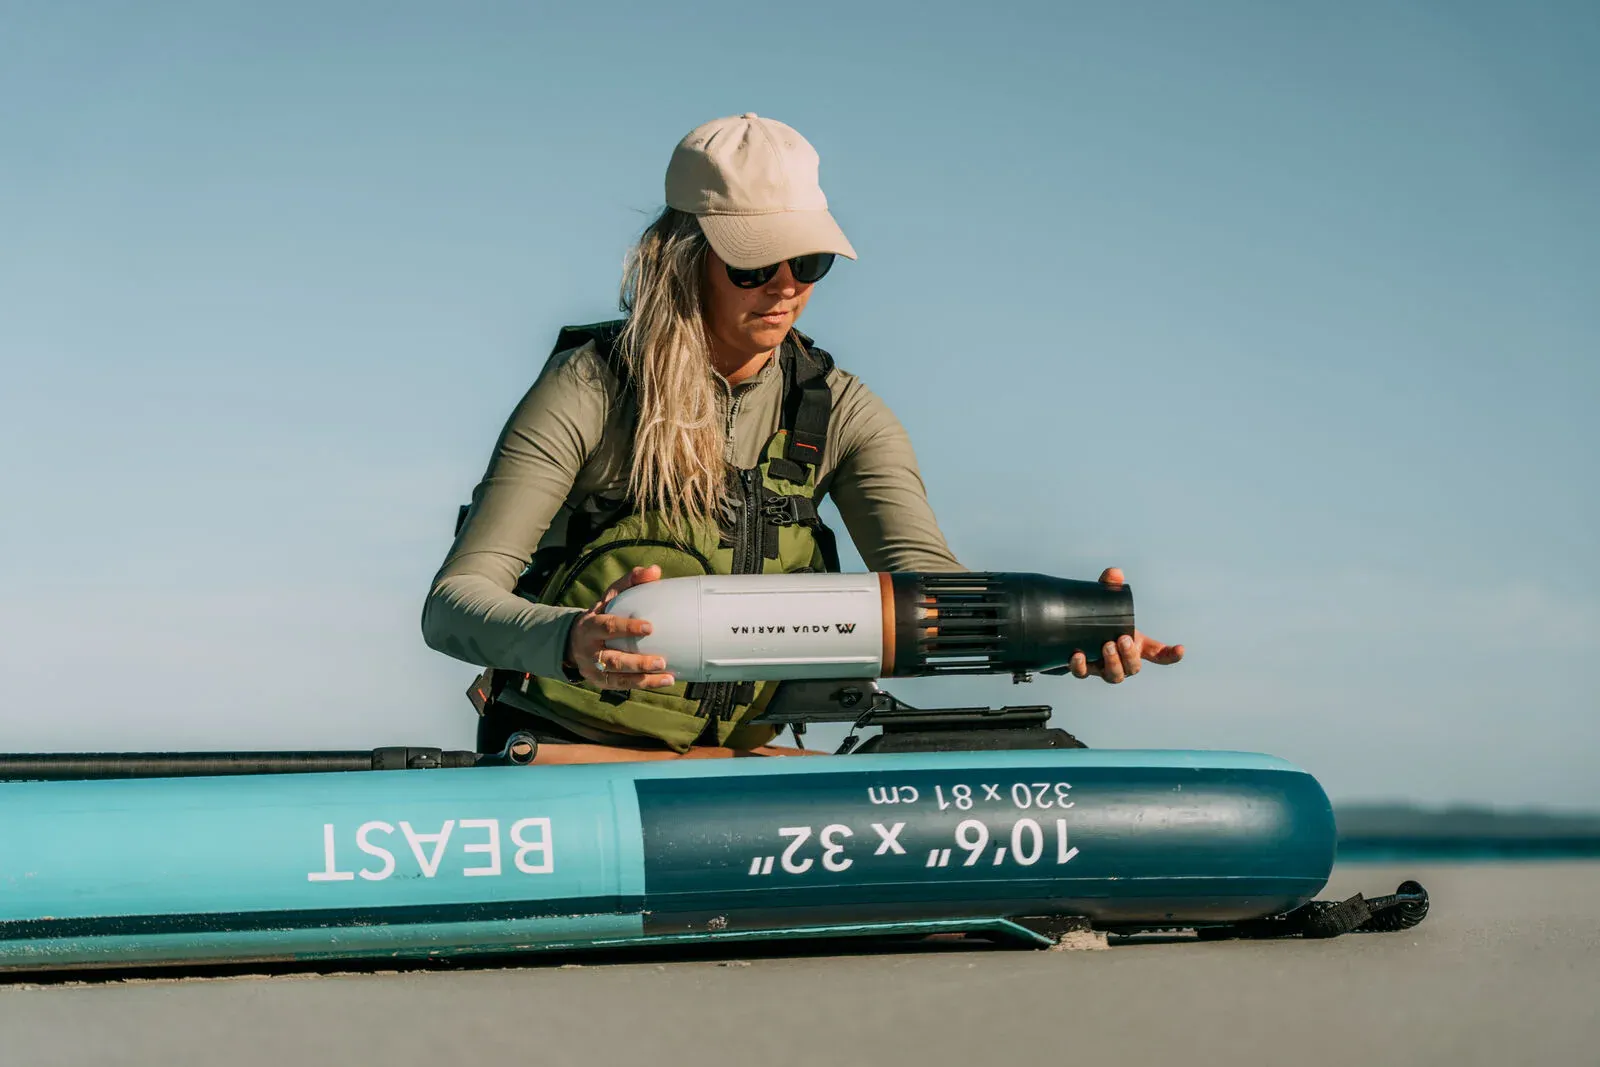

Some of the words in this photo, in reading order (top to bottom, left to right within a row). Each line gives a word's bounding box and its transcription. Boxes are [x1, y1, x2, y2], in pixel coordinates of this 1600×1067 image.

[731, 626, 785, 634] MARINA
[792, 625, 830, 633] AQUA
[867, 785, 919, 805] cm
[933, 784, 974, 811] 81
[981, 783, 1002, 801] x
[1011, 782, 1074, 809] 320
[307, 816, 554, 882] BEAST
[748, 823, 854, 875] 32"
[869, 821, 907, 856] x
